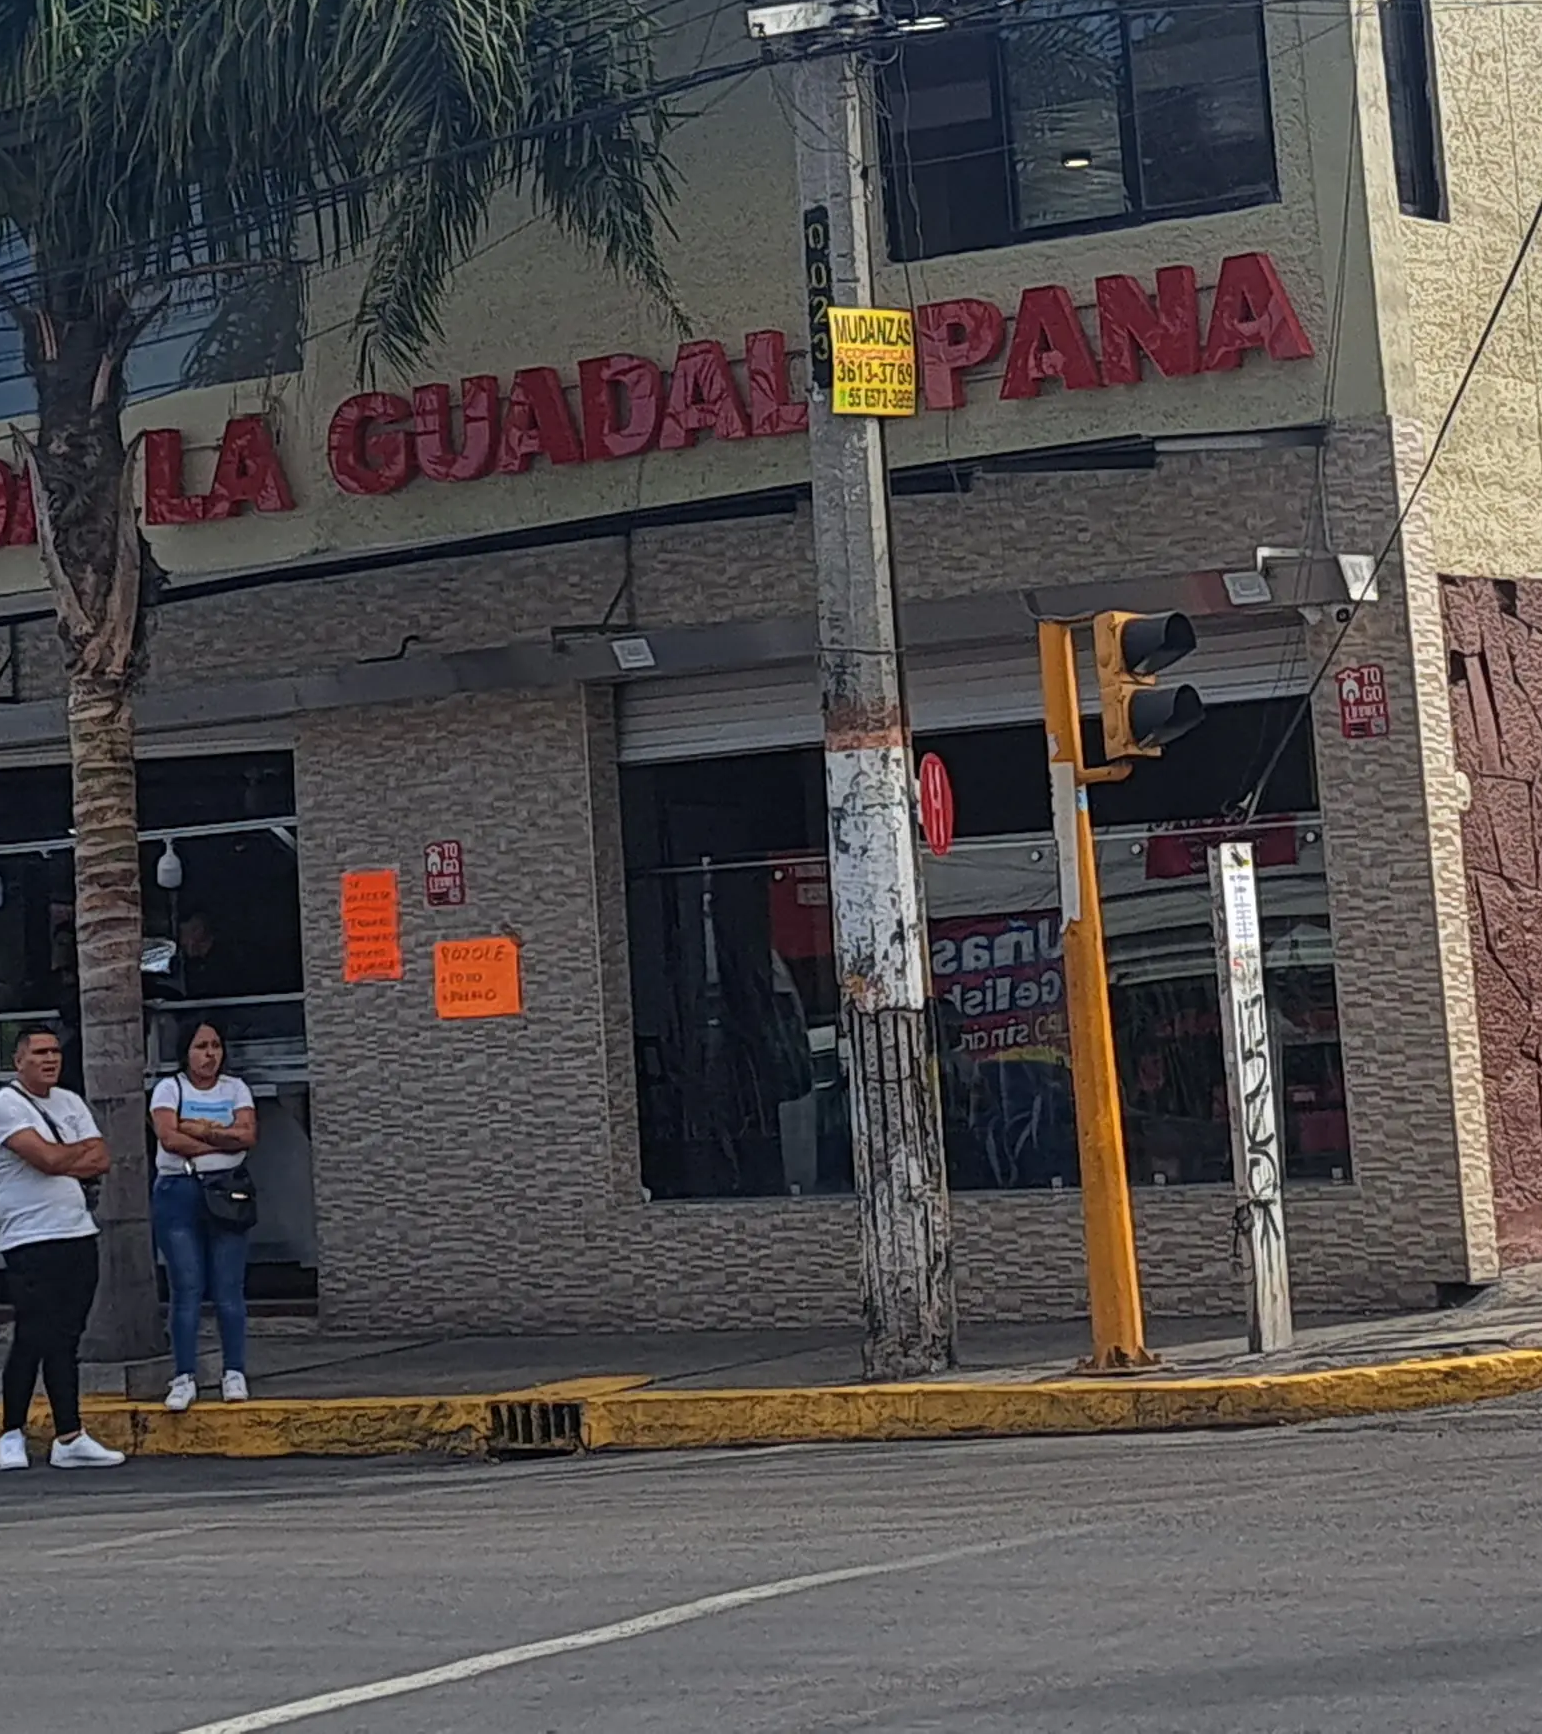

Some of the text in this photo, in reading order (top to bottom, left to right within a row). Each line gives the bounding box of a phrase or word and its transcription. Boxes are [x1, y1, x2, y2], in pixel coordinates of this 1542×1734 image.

[834, 314, 911, 346] MUDANZAS
[143, 416, 295, 526] LA
[329, 251, 1313, 496] GUADALPANA
[1360, 667, 1380, 684] TO
[1363, 686, 1382, 702] GO
[441, 944, 506, 965] POZOLE
